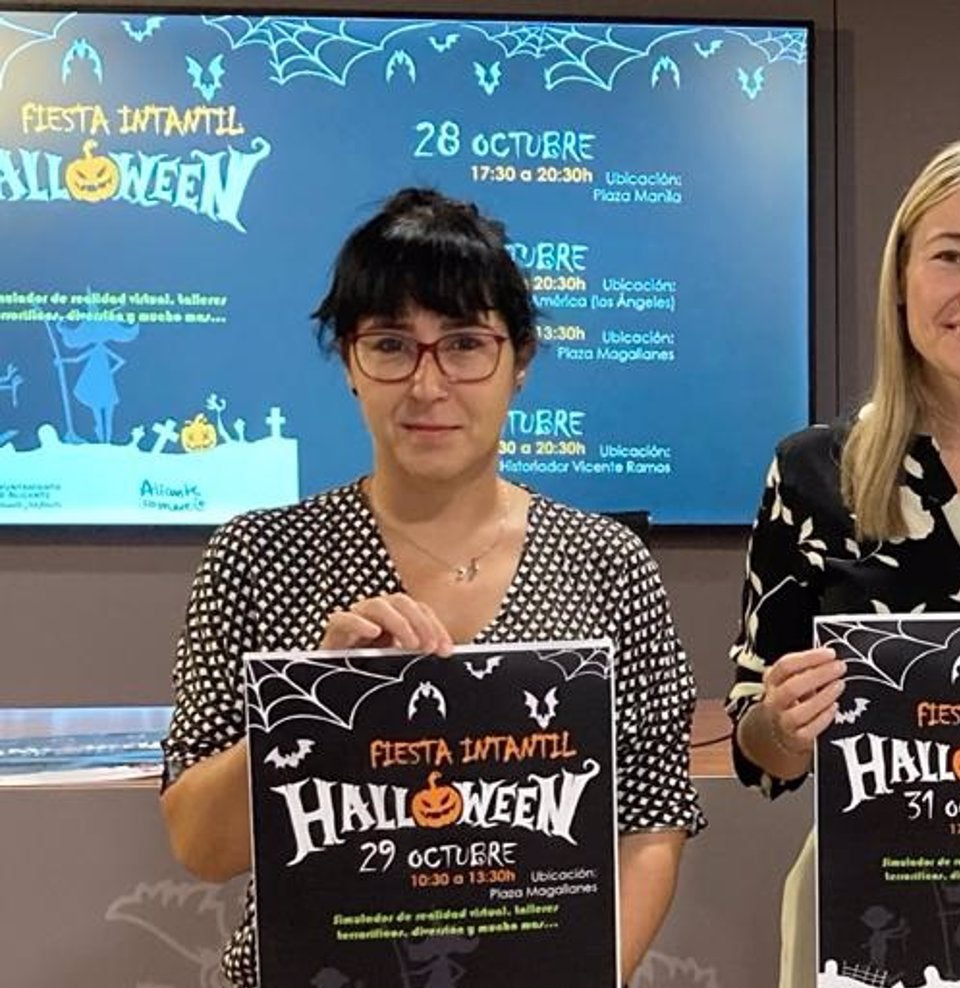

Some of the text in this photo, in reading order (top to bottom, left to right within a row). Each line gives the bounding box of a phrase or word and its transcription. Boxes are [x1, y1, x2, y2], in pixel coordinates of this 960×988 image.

[21, 102, 110, 136] FIESTA
[413, 121, 596, 162] 28 OCTUBRE
[0, 136, 271, 233] ALLOWEEN
[471, 165, 682, 187] 17:30 a 20:30h Ubicación:
[594, 189, 682, 204] Plaza Manila
[504, 242, 589, 273] TUBRE
[532, 276, 677, 292] 20:30h Ubicación:
[591, 294, 613, 309] (los
[617, 293, 676, 312] Ángeles)
[535, 325, 675, 345] 13:30h Ubicación:
[556, 347, 675, 363] Plaza Magallanes
[508, 409, 586, 438] TUBRE
[520, 443, 532, 454] a
[536, 441, 586, 455] 20:30h
[600, 444, 671, 458] Ubicación:
[499, 460, 671, 473] Historiador Vicente Ramos
[370, 738, 453, 768] FIESTA
[270, 758, 600, 867] HALLOWEEN
[904, 789, 935, 819] 31
[359, 839, 518, 872] 29 OCTUBRE
[411, 873, 449, 887] 10:30
[453, 875, 464, 885] a
[469, 869, 516, 883] 13:30h
[490, 883, 597, 900] Plaza Magallanes
